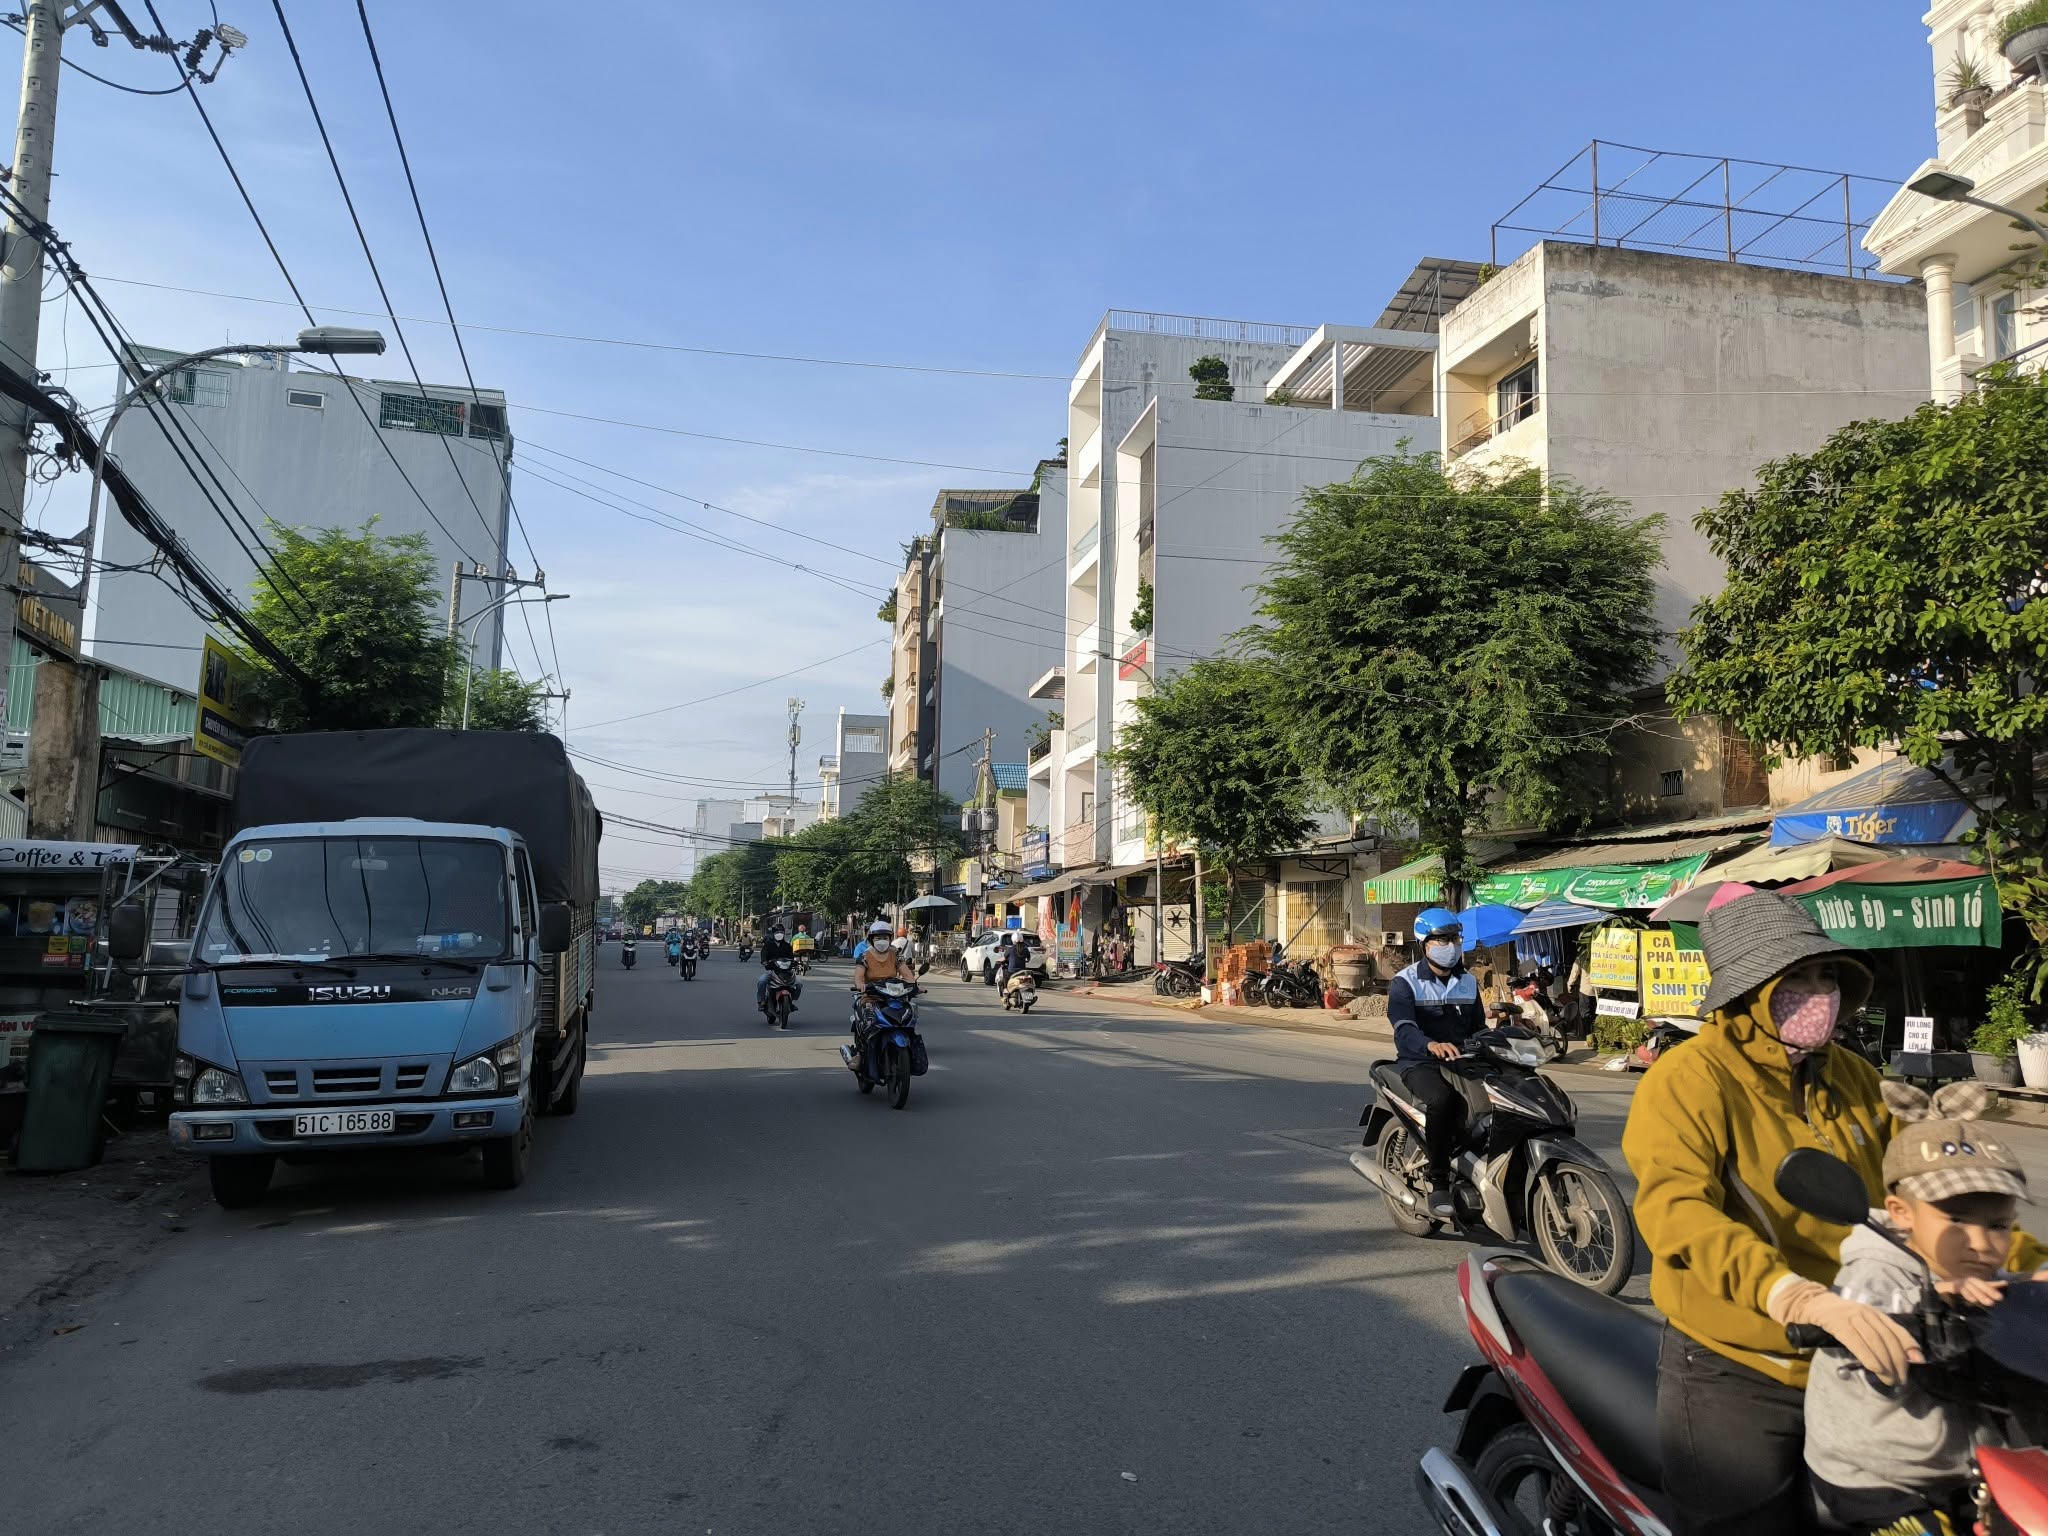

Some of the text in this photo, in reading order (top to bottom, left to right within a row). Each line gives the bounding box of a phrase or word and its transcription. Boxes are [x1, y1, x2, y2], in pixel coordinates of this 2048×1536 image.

[49, 611, 75, 649] NAM
[1845, 811, 1898, 842] Tiger
[0, 847, 62, 867] Coffee
[69, 851, 84, 866] &
[1861, 894, 1886, 931] ép
[1911, 895, 1956, 929] Sinh
[1963, 883, 1983, 928] tố
[1652, 934, 1671, 948] CÀ
[1647, 951, 1675, 962] PHA
[223, 986, 277, 994] FORWARD
[308, 985, 391, 1001] ISUZU
[1651, 983, 1687, 996] SINH
[1921, 1032, 1928, 1040] XE
